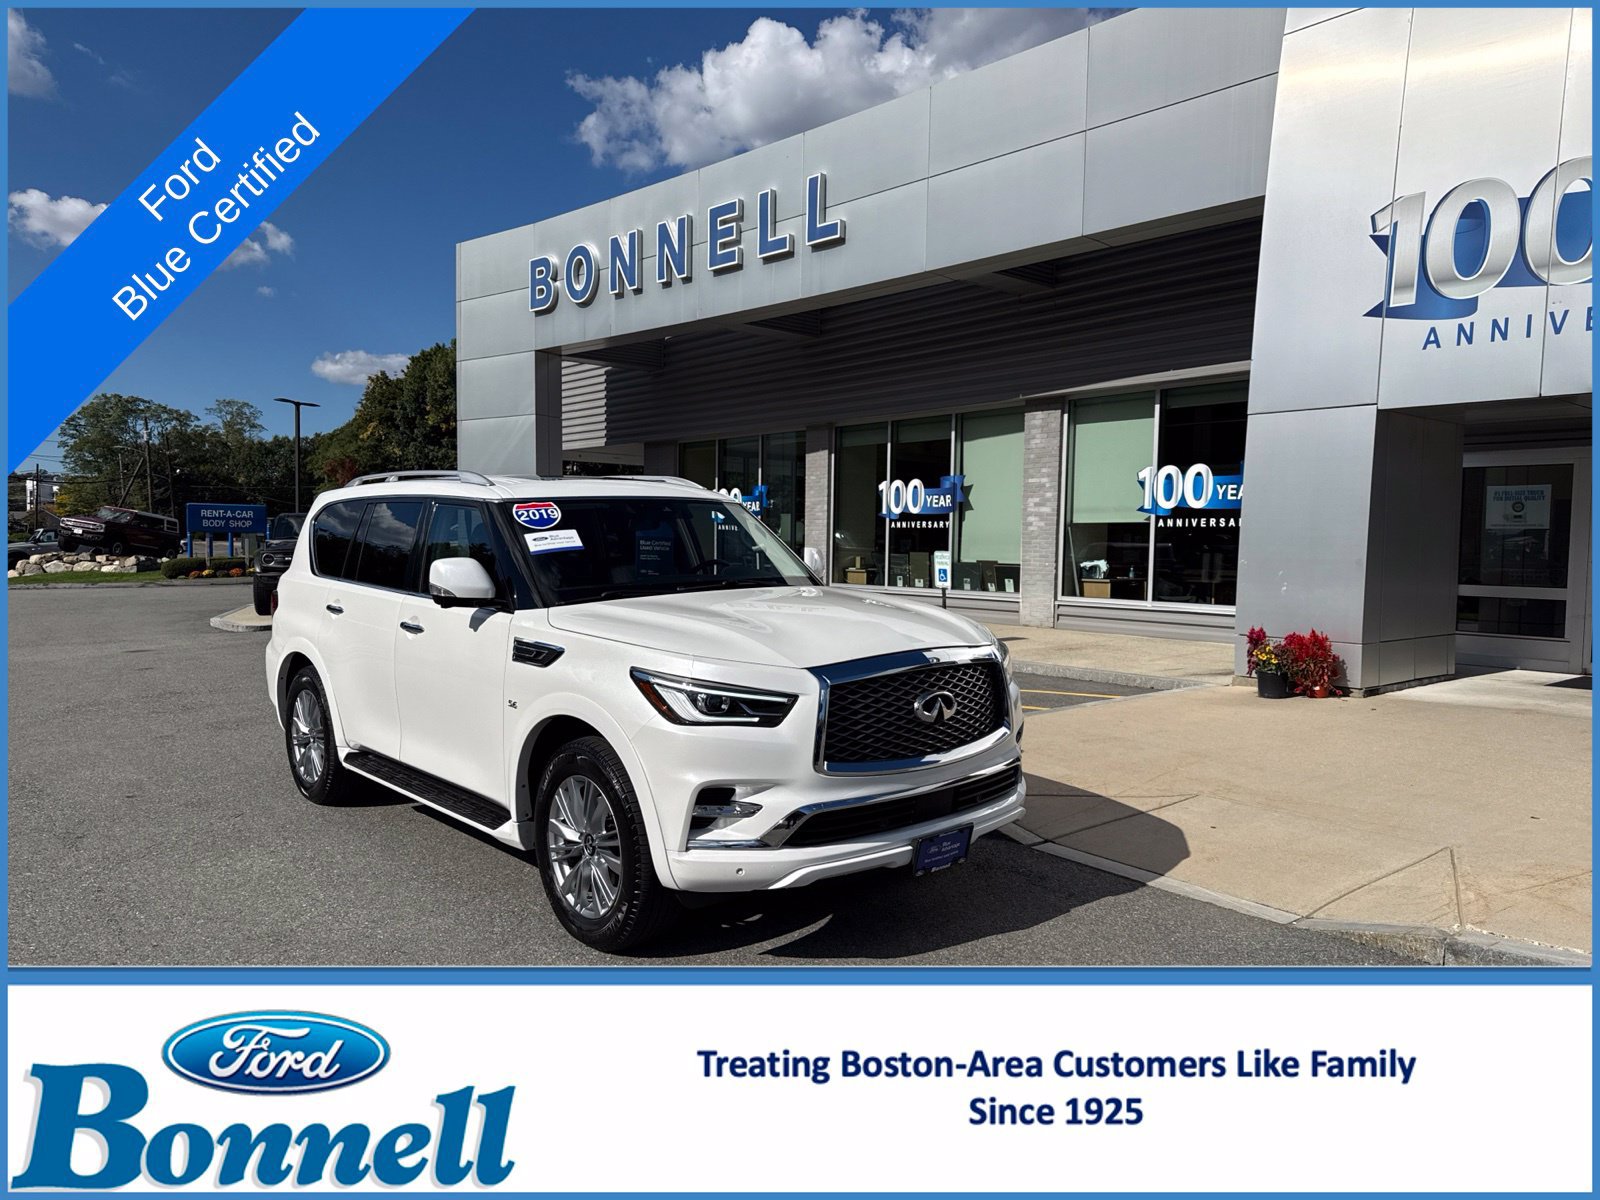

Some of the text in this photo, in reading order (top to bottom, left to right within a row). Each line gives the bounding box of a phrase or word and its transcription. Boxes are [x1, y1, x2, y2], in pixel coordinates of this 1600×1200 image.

[529, 172, 846, 313] BONNELL
[1137, 463, 1213, 509] 100
[878, 478, 952, 514] 100 YEAR
[200, 509, 254, 518] RENT-A-CAR
[518, 508, 558, 521] 2019
[202, 519, 253, 528] BODY SHOP
[891, 521, 950, 529] ANNIVERSARY
